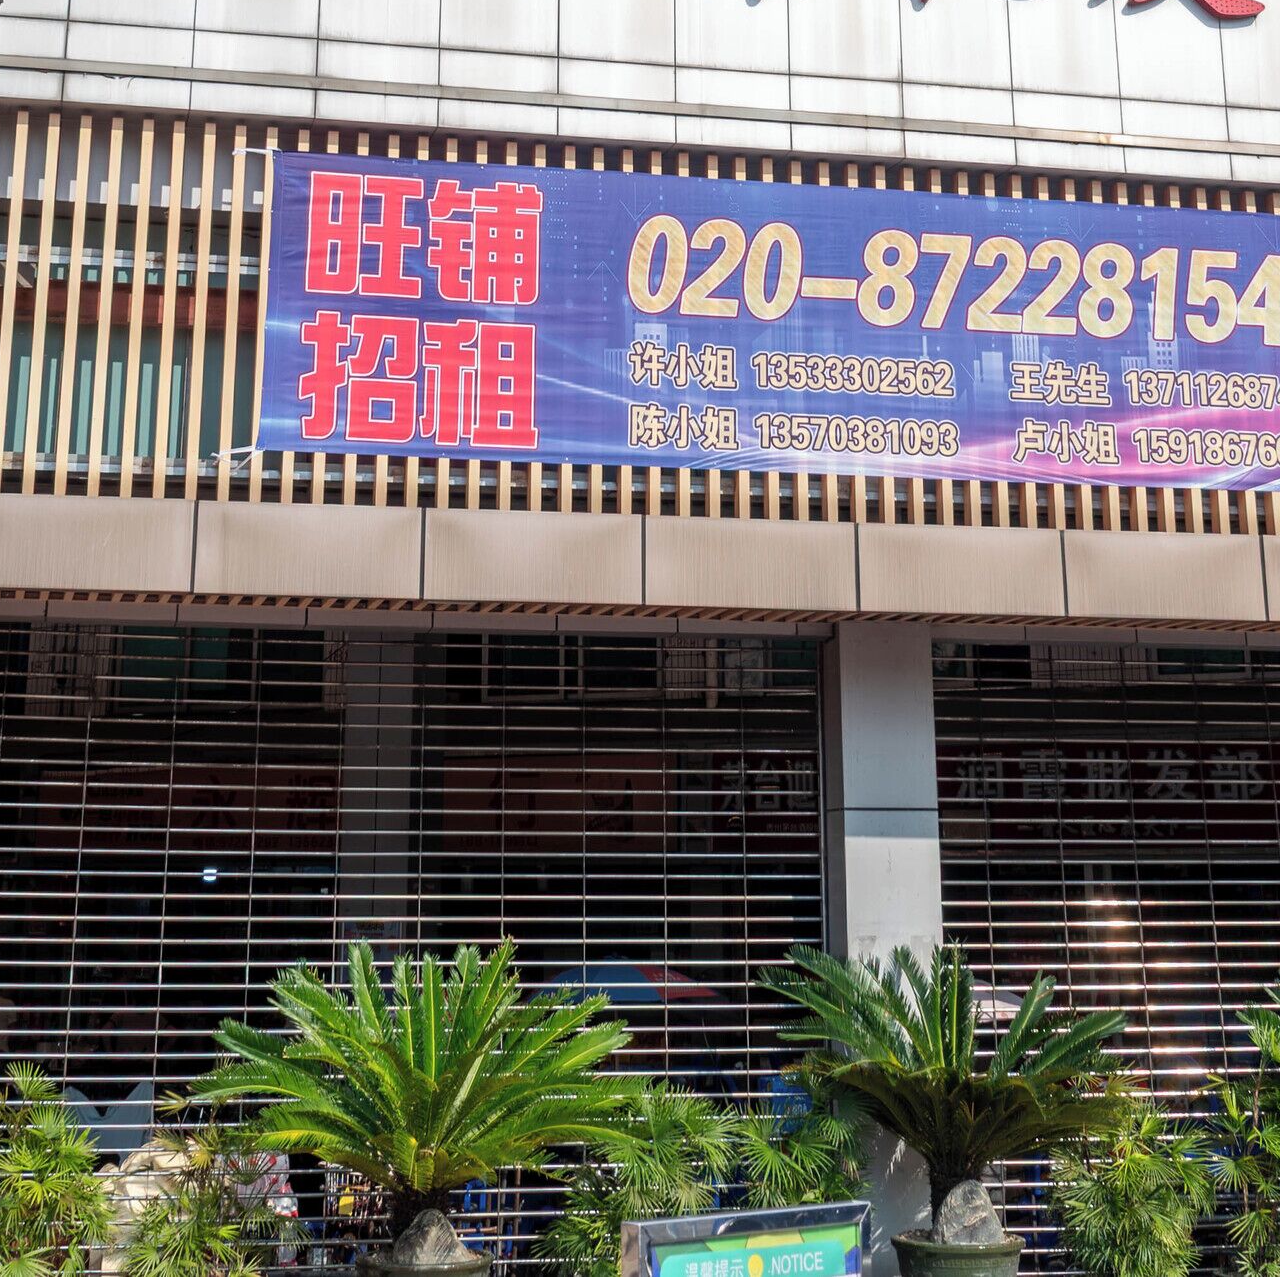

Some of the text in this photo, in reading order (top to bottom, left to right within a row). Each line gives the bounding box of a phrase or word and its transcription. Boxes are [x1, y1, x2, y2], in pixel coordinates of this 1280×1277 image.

[304, 170, 545, 306] 旺铺
[297, 309, 539, 452] 招租
[627, 340, 738, 391] 许小姐
[750, 351, 956, 399] 13533302562
[1008, 360, 1113, 408] 王先生
[627, 402, 739, 453] 陈小姐
[753, 411, 961, 459] 13570381093
[1012, 418, 1120, 466] 卢小姐
[770, 1250, 825, 1275] NOTICE
